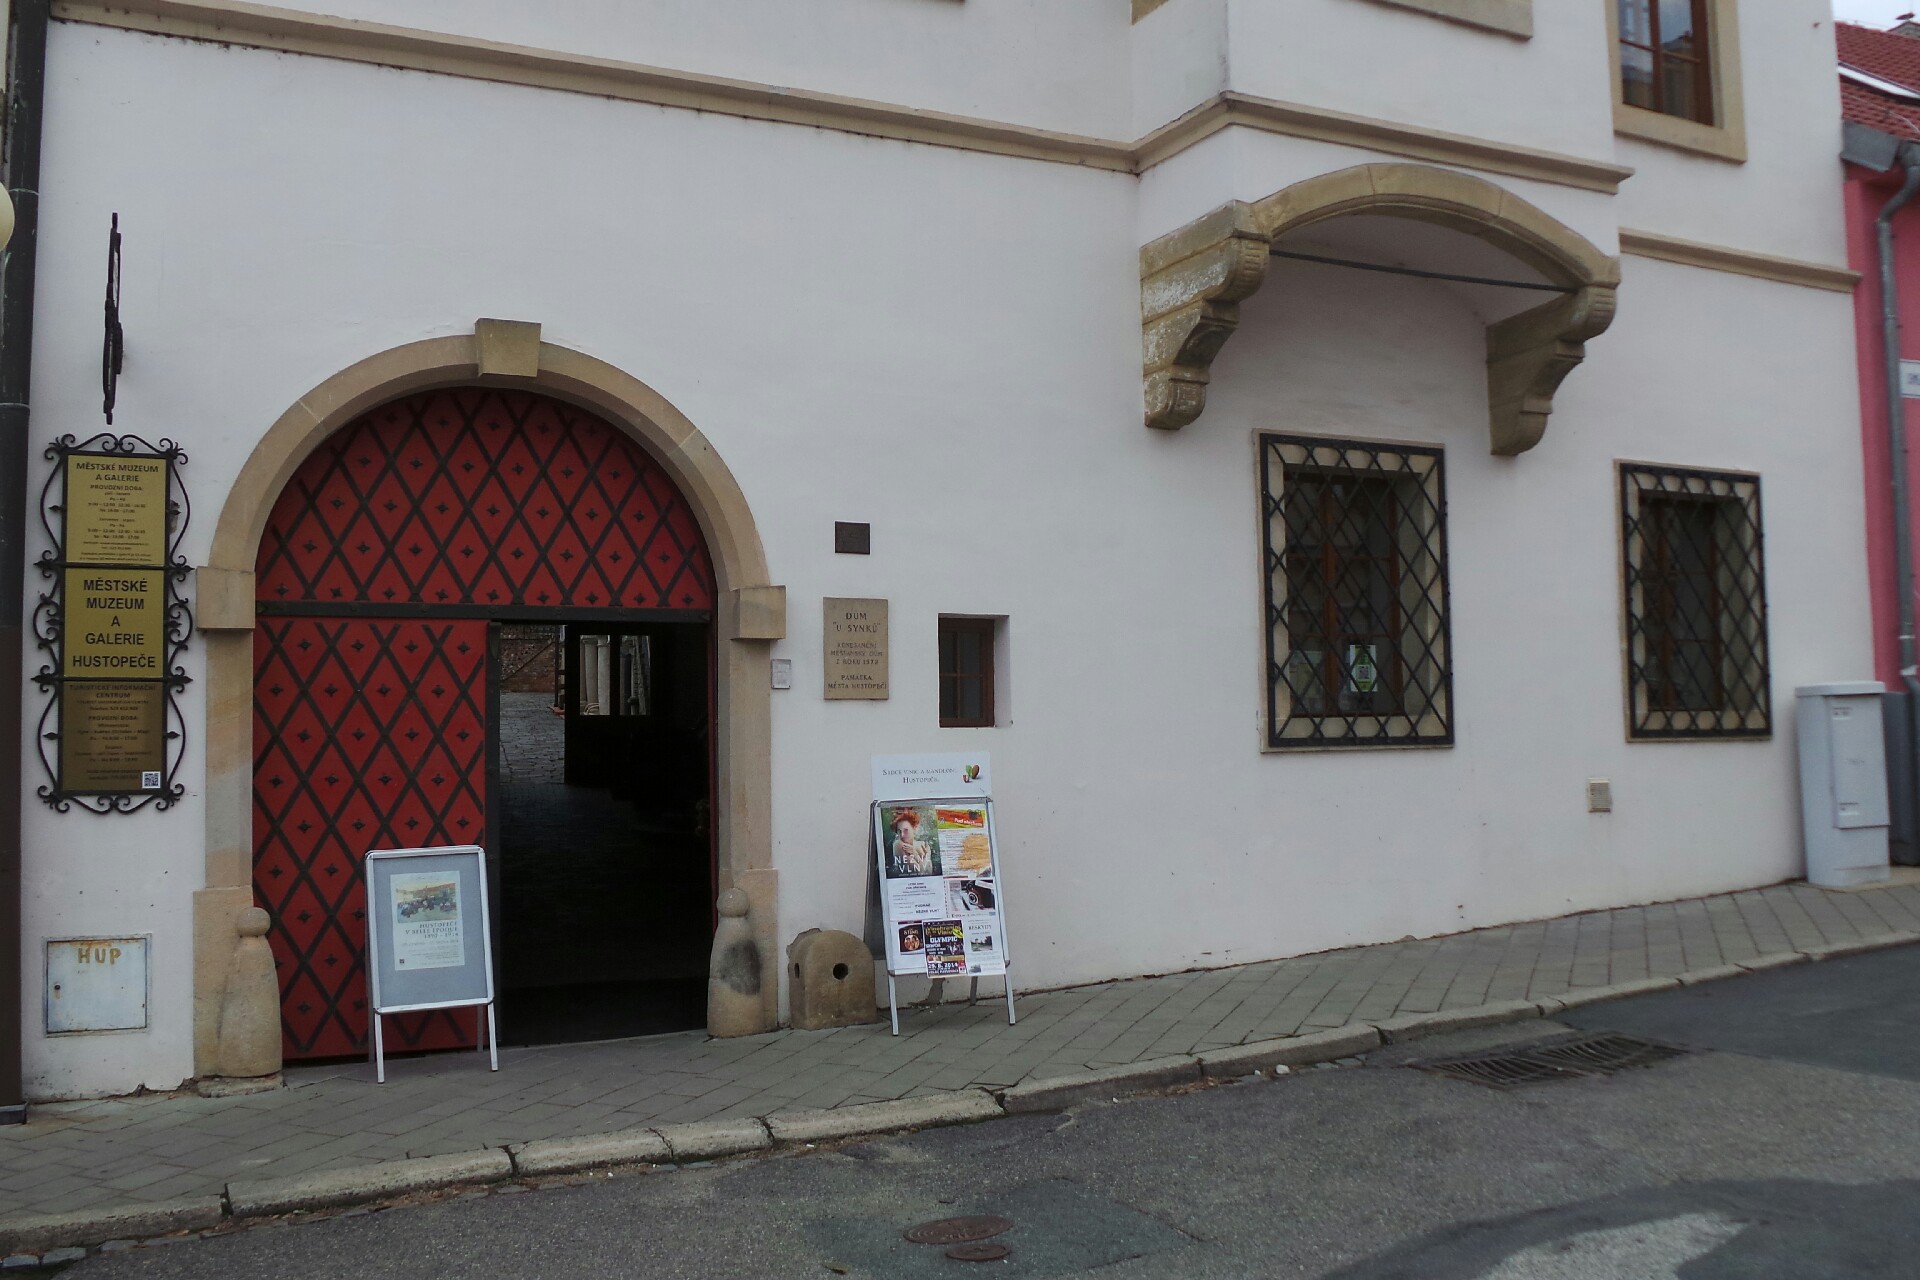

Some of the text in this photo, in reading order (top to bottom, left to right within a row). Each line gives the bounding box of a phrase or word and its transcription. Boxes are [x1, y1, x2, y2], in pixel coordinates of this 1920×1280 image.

[76, 462, 158, 473] MĚSTSKÉ MUZEUM
[95, 473, 140, 482] A GALERIE
[83, 577, 148, 592] MĚSTSKÉ
[86, 597, 145, 610] MUZEUM
[110, 615, 121, 627] A
[85, 632, 145, 645] GALERIE
[72, 653, 156, 668] HUSTOPEČE
[929, 936, 958, 944] OLYMPIC
[78, 947, 122, 965] HUP
